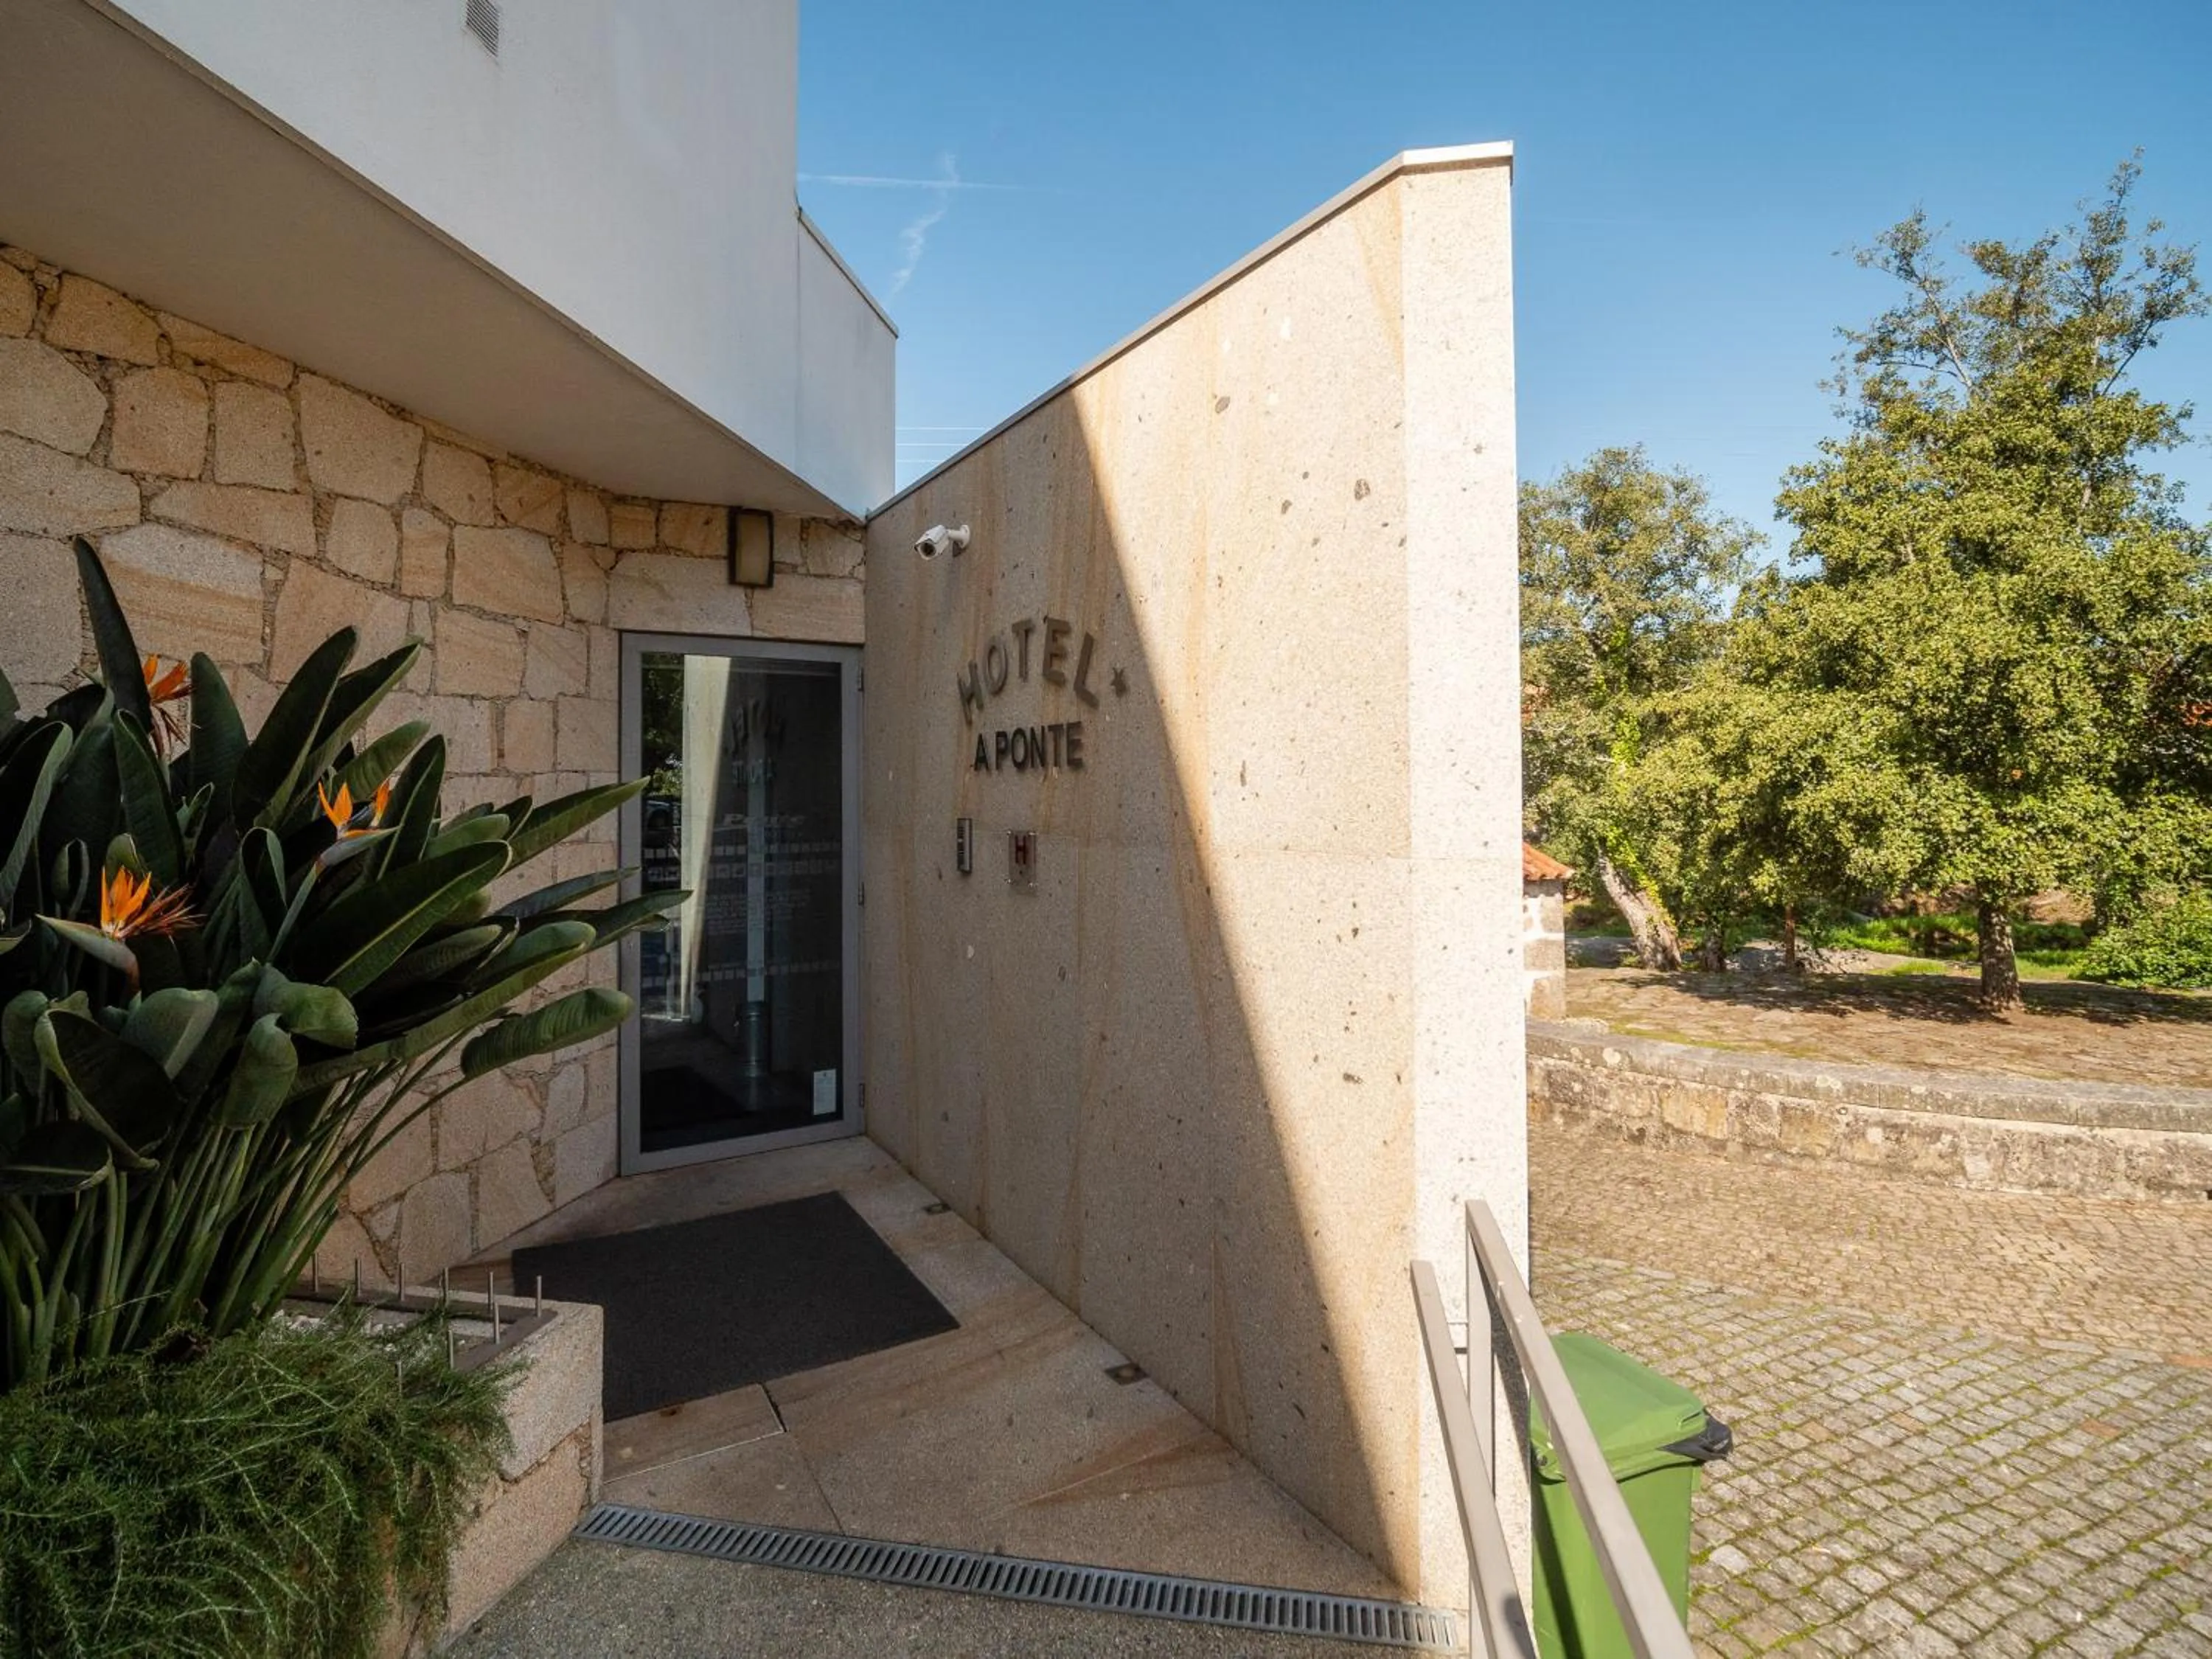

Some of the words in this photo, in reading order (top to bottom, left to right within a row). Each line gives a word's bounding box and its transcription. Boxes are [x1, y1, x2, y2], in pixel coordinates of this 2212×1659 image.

[957, 616, 1099, 725] HOTEL
[973, 733, 990, 771] A
[995, 721, 1084, 771] PONTE
[1015, 835, 1027, 864] H
